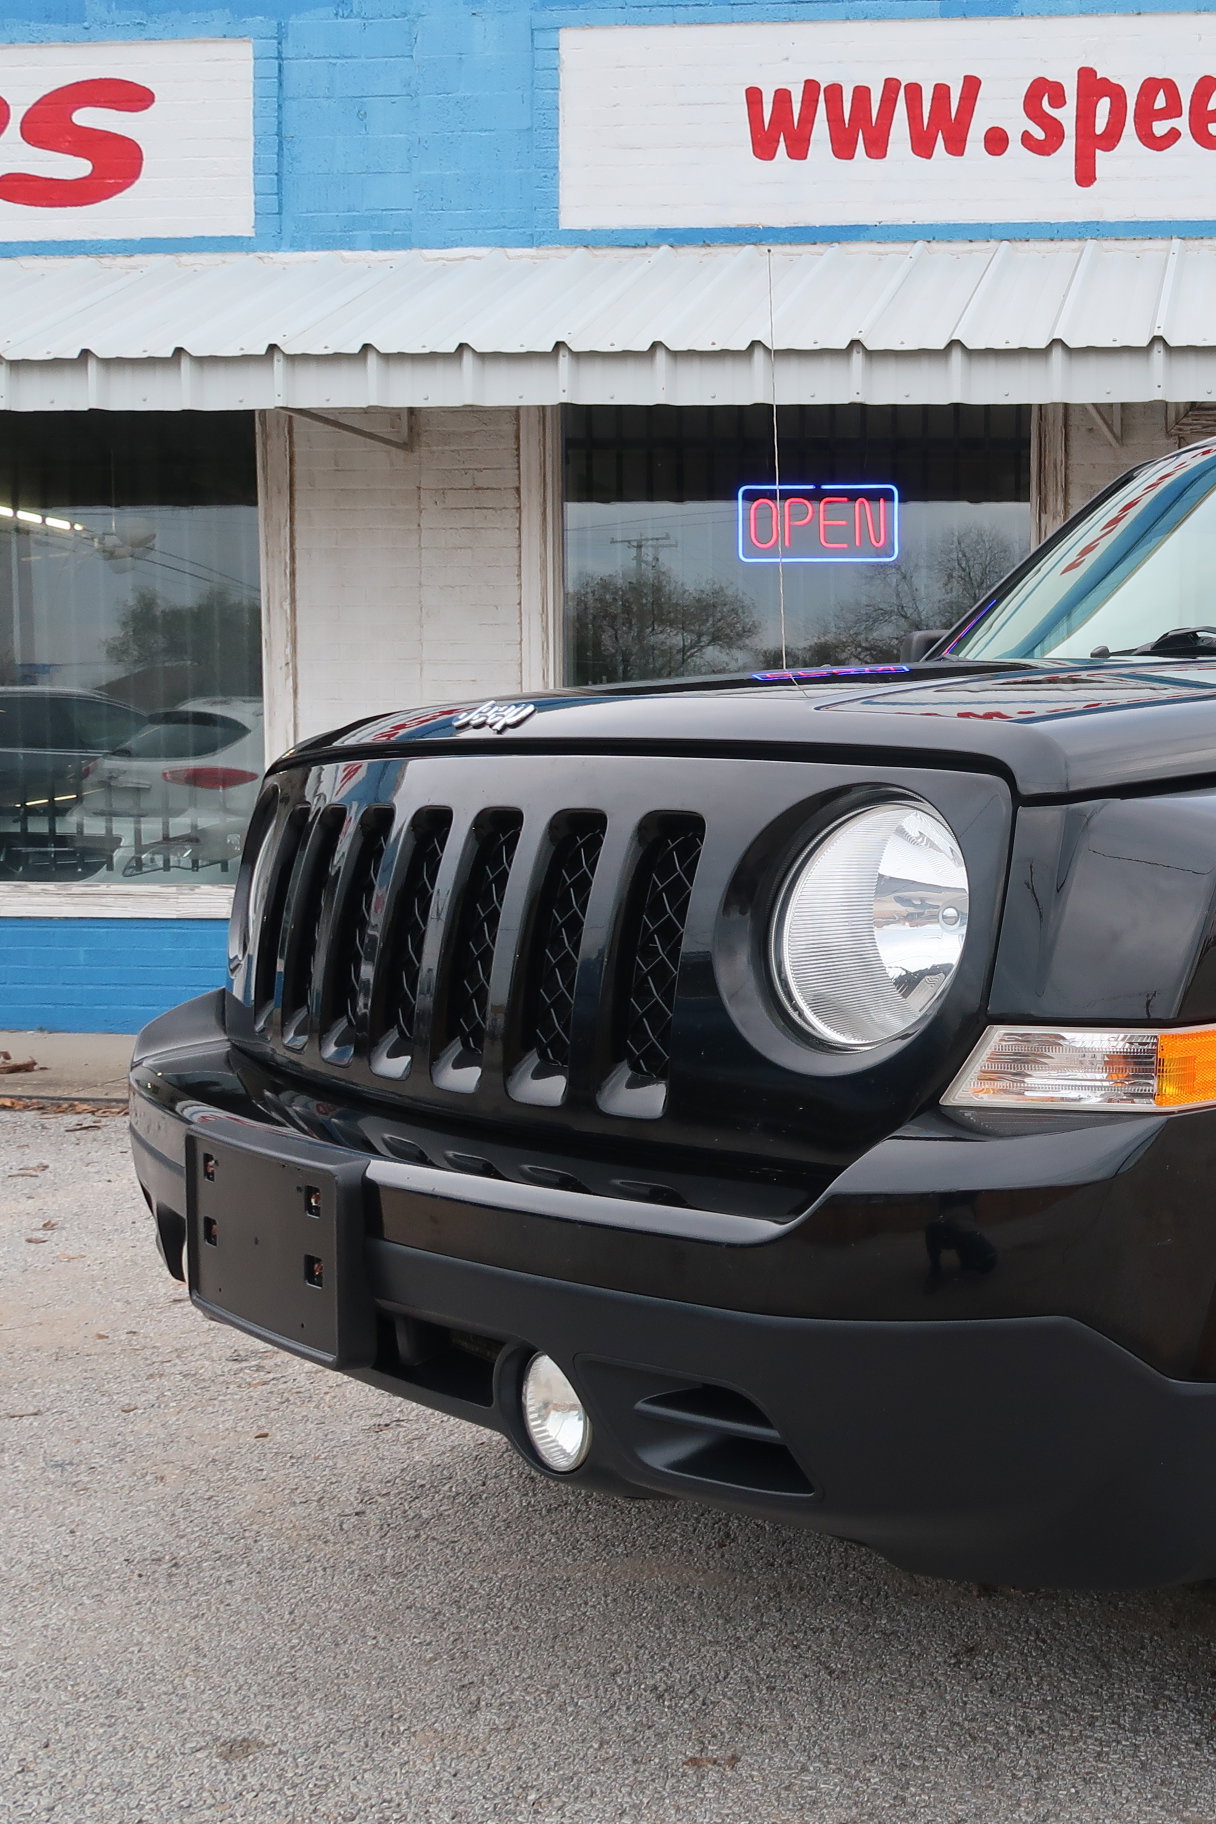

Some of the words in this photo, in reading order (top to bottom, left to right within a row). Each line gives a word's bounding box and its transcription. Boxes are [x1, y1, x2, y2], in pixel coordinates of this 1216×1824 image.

[0, 77, 155, 207] S
[750, 497, 886, 549] OPEN
[452, 700, 535, 731] Jeep
